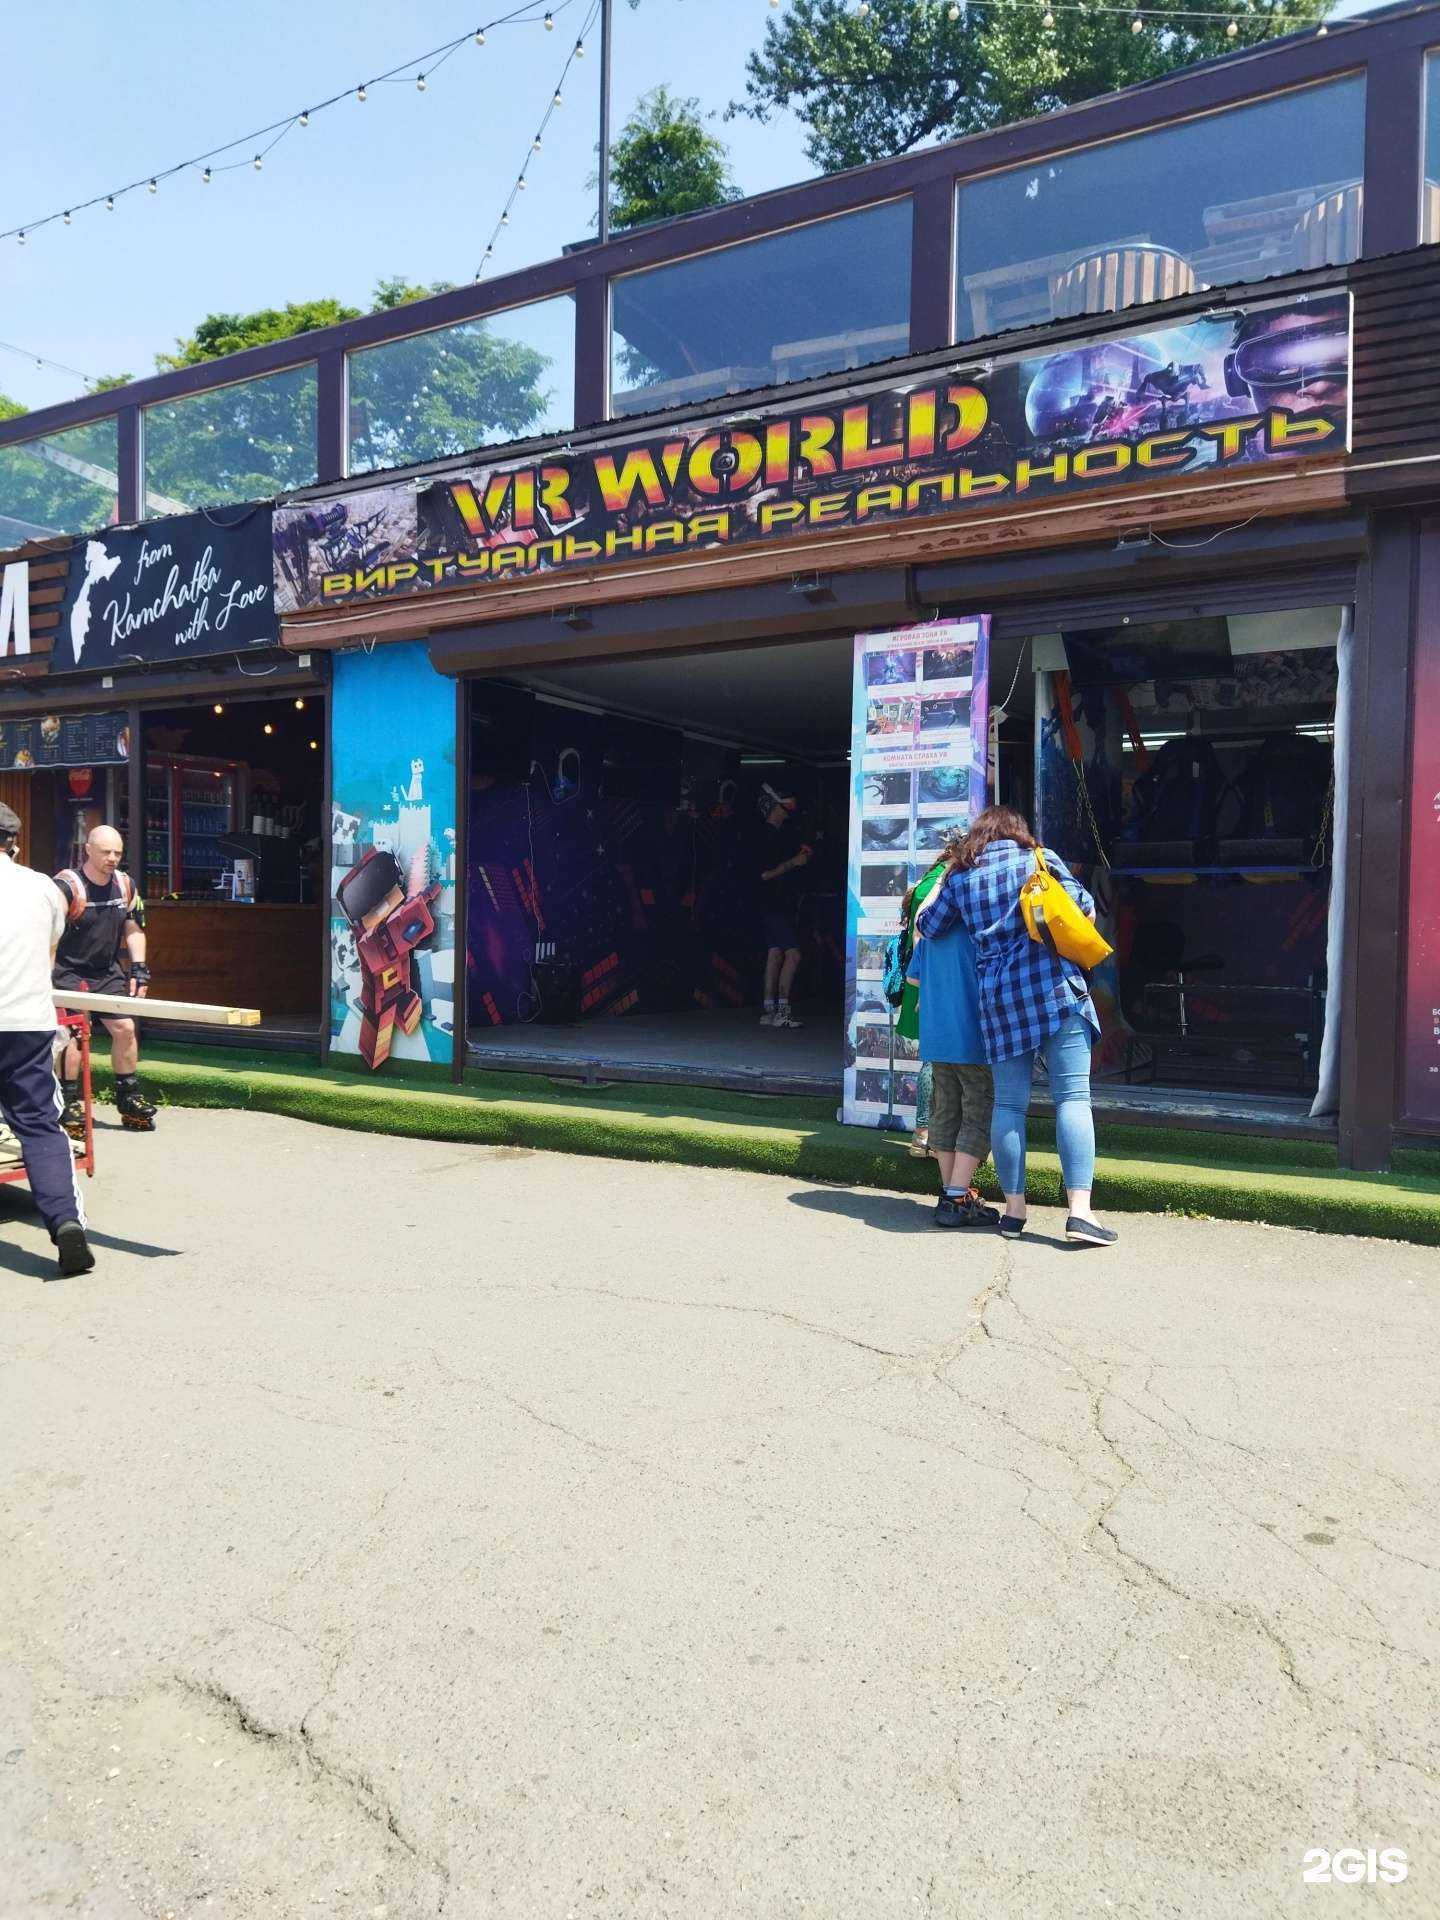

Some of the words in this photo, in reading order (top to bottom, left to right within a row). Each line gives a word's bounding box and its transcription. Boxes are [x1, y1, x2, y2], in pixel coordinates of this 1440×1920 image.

[322, 510, 730, 598] ВИРТУАЛЬНАЯ
[761, 410, 1336, 535] РЕАЛЬНОСТЬ
[449, 465, 576, 537] VR
[593, 384, 990, 512] WORLD
[102, 545, 222, 646] Kamchatka
[133, 539, 173, 586] from
[175, 595, 210, 646] with
[215, 579, 269, 631] Love
